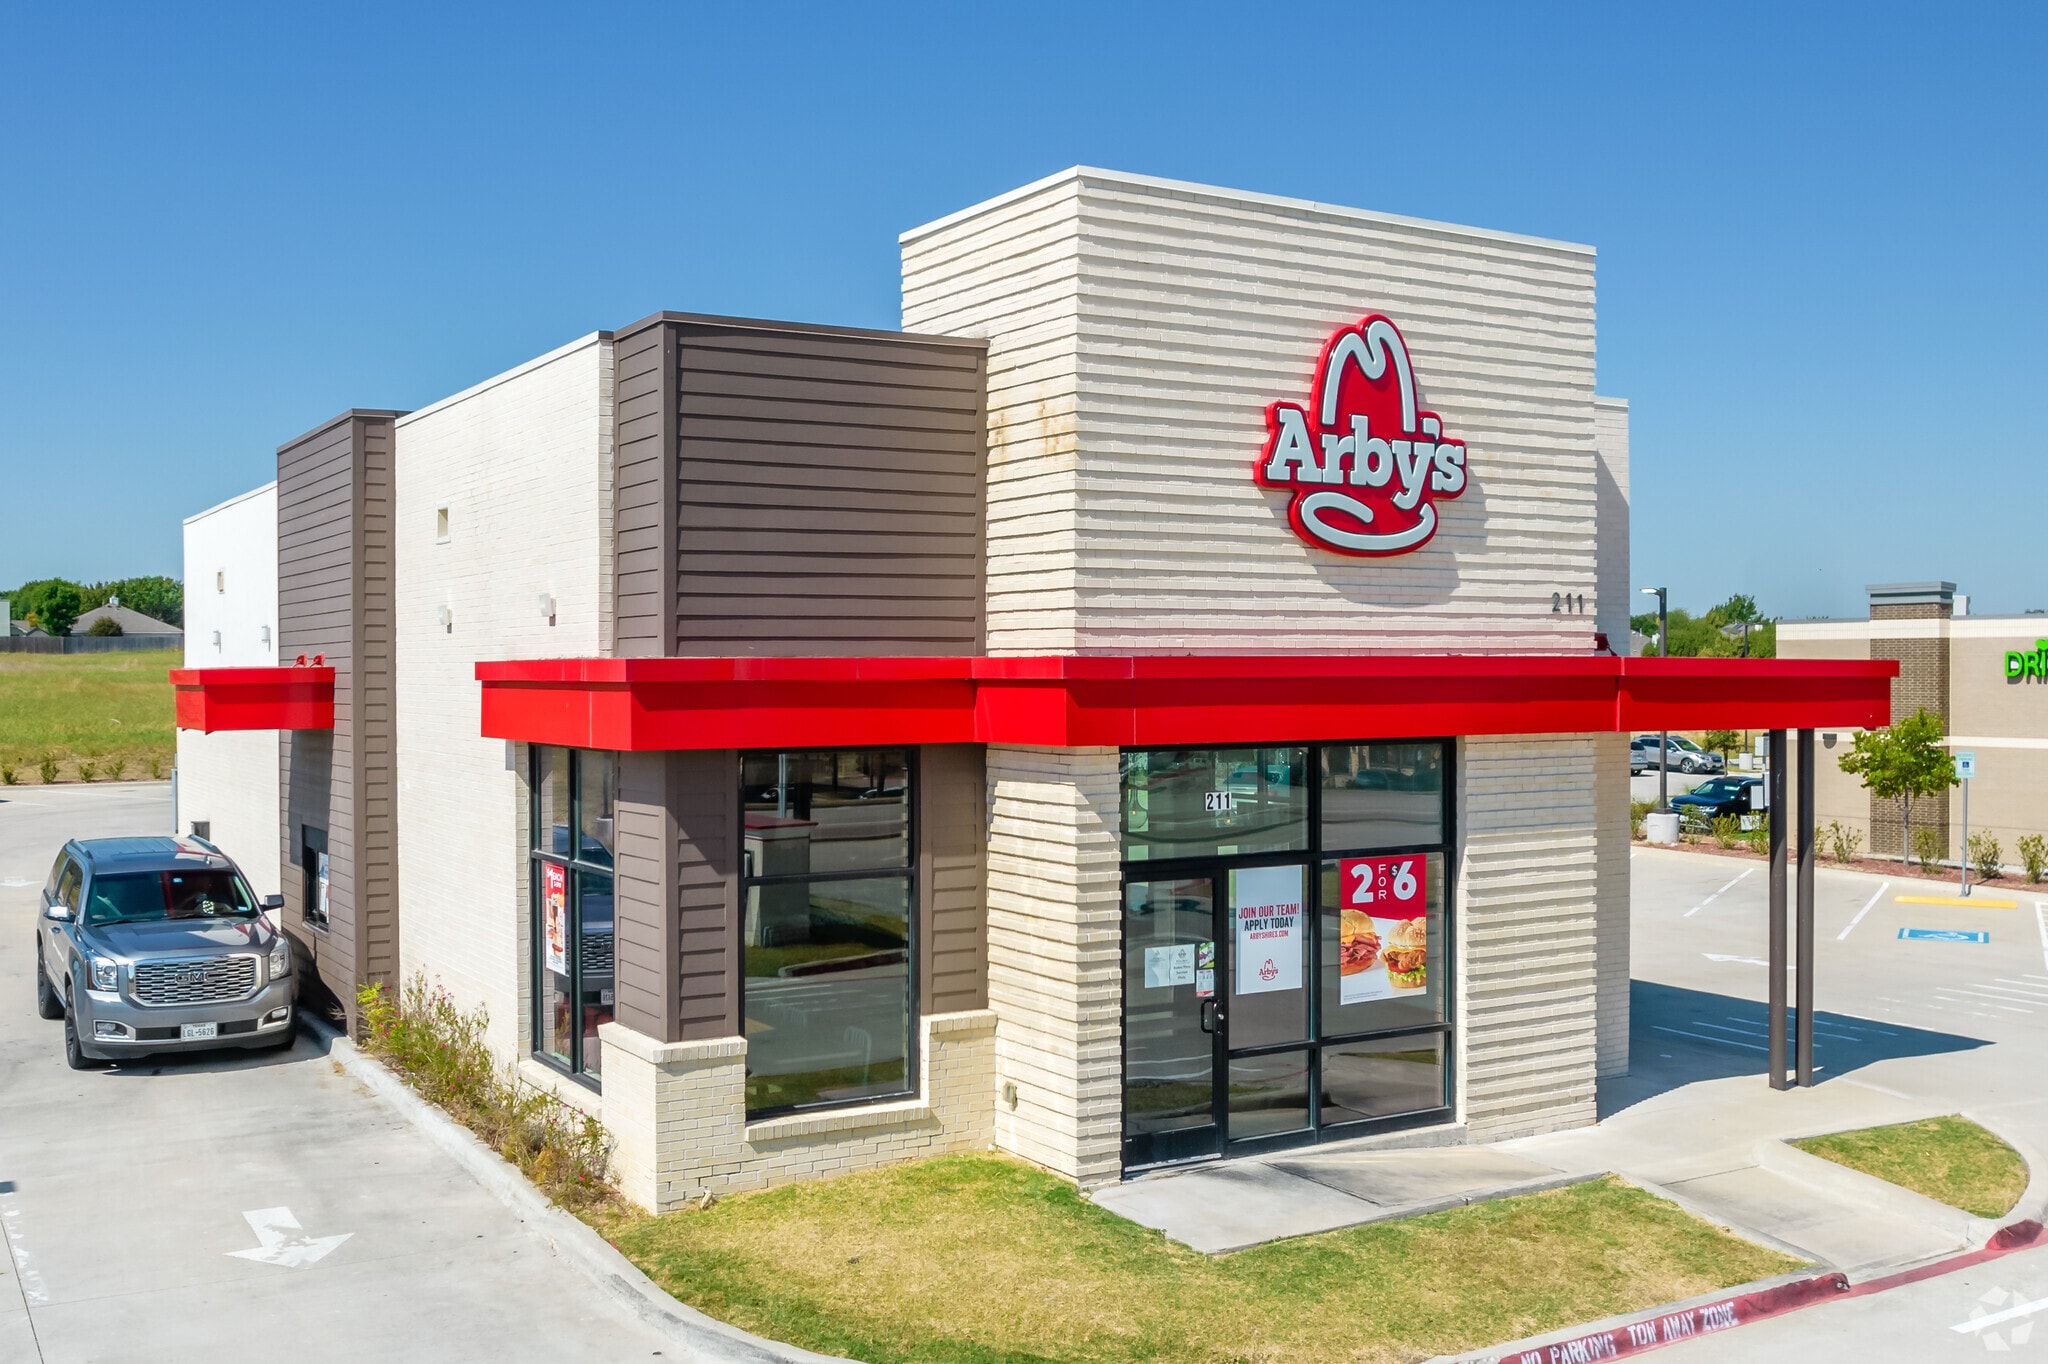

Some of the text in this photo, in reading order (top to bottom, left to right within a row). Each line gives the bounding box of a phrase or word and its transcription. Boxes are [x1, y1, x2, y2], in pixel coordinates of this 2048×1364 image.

[1266, 407, 1465, 510] Arby's
[1552, 592, 1583, 613] 211
[1206, 793, 1230, 810] 211
[1350, 863, 1374, 904] 2
[1378, 864, 1387, 900] FOR
[1238, 903, 1300, 920] JOIN OUR TEAM!
[1244, 916, 1295, 932] APPLY TODAY
[174, 970, 217, 984] GMC
[1520, 1301, 1739, 1364] NO PARKING TOW AWAY ZONE
